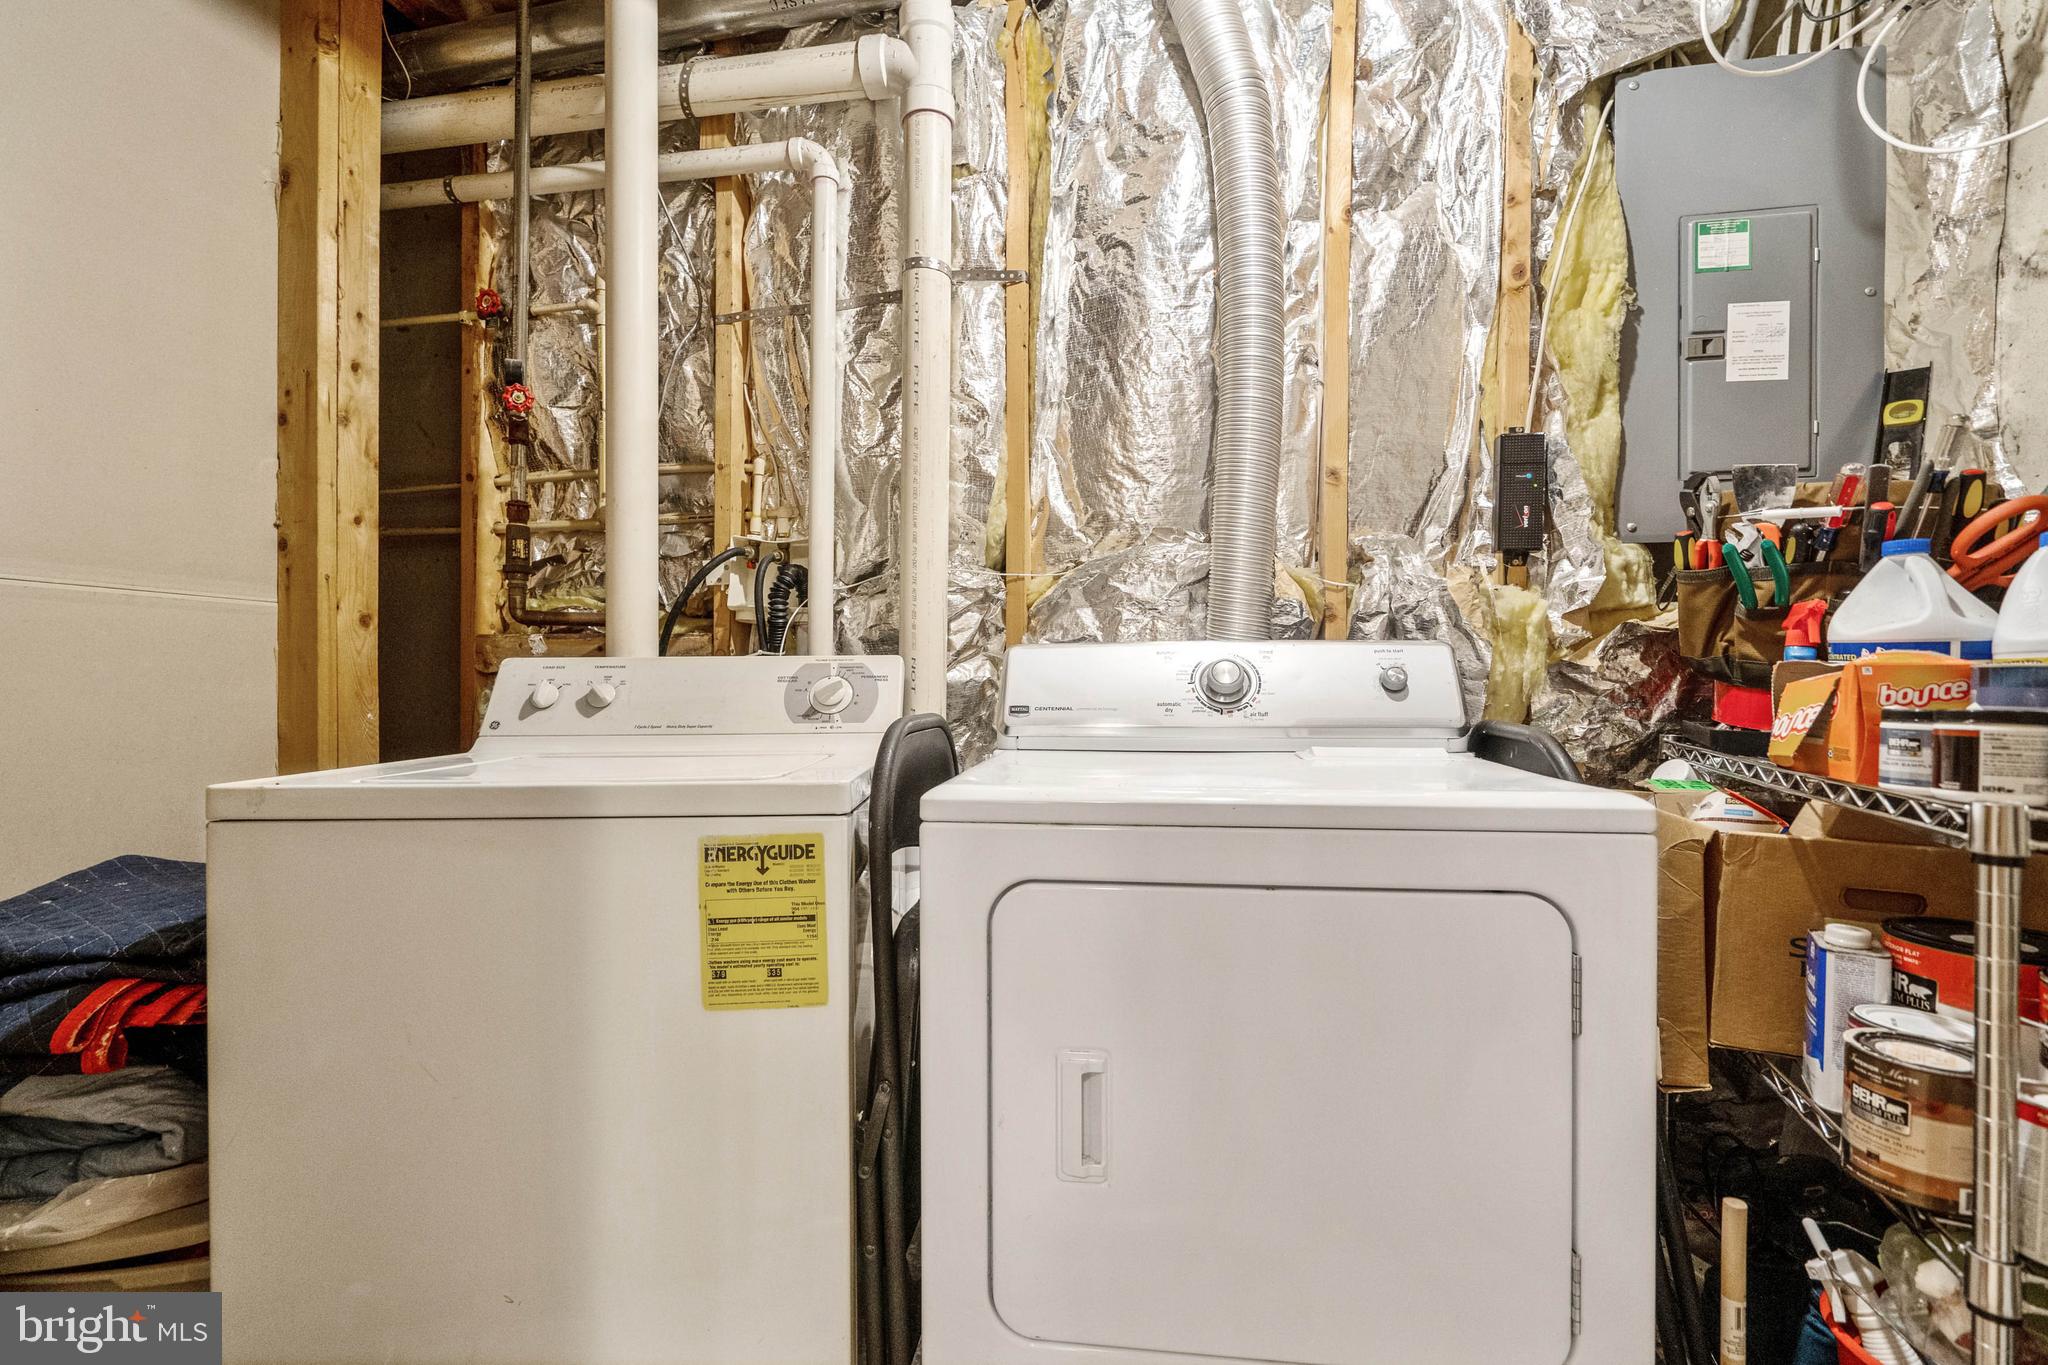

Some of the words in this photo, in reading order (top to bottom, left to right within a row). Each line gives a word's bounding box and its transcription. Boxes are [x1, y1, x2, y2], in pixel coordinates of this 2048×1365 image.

[1879, 680, 1970, 707] bounce
[704, 844, 816, 863] ENERGYGUIDE
[1851, 1083, 1888, 1111] BEHR
